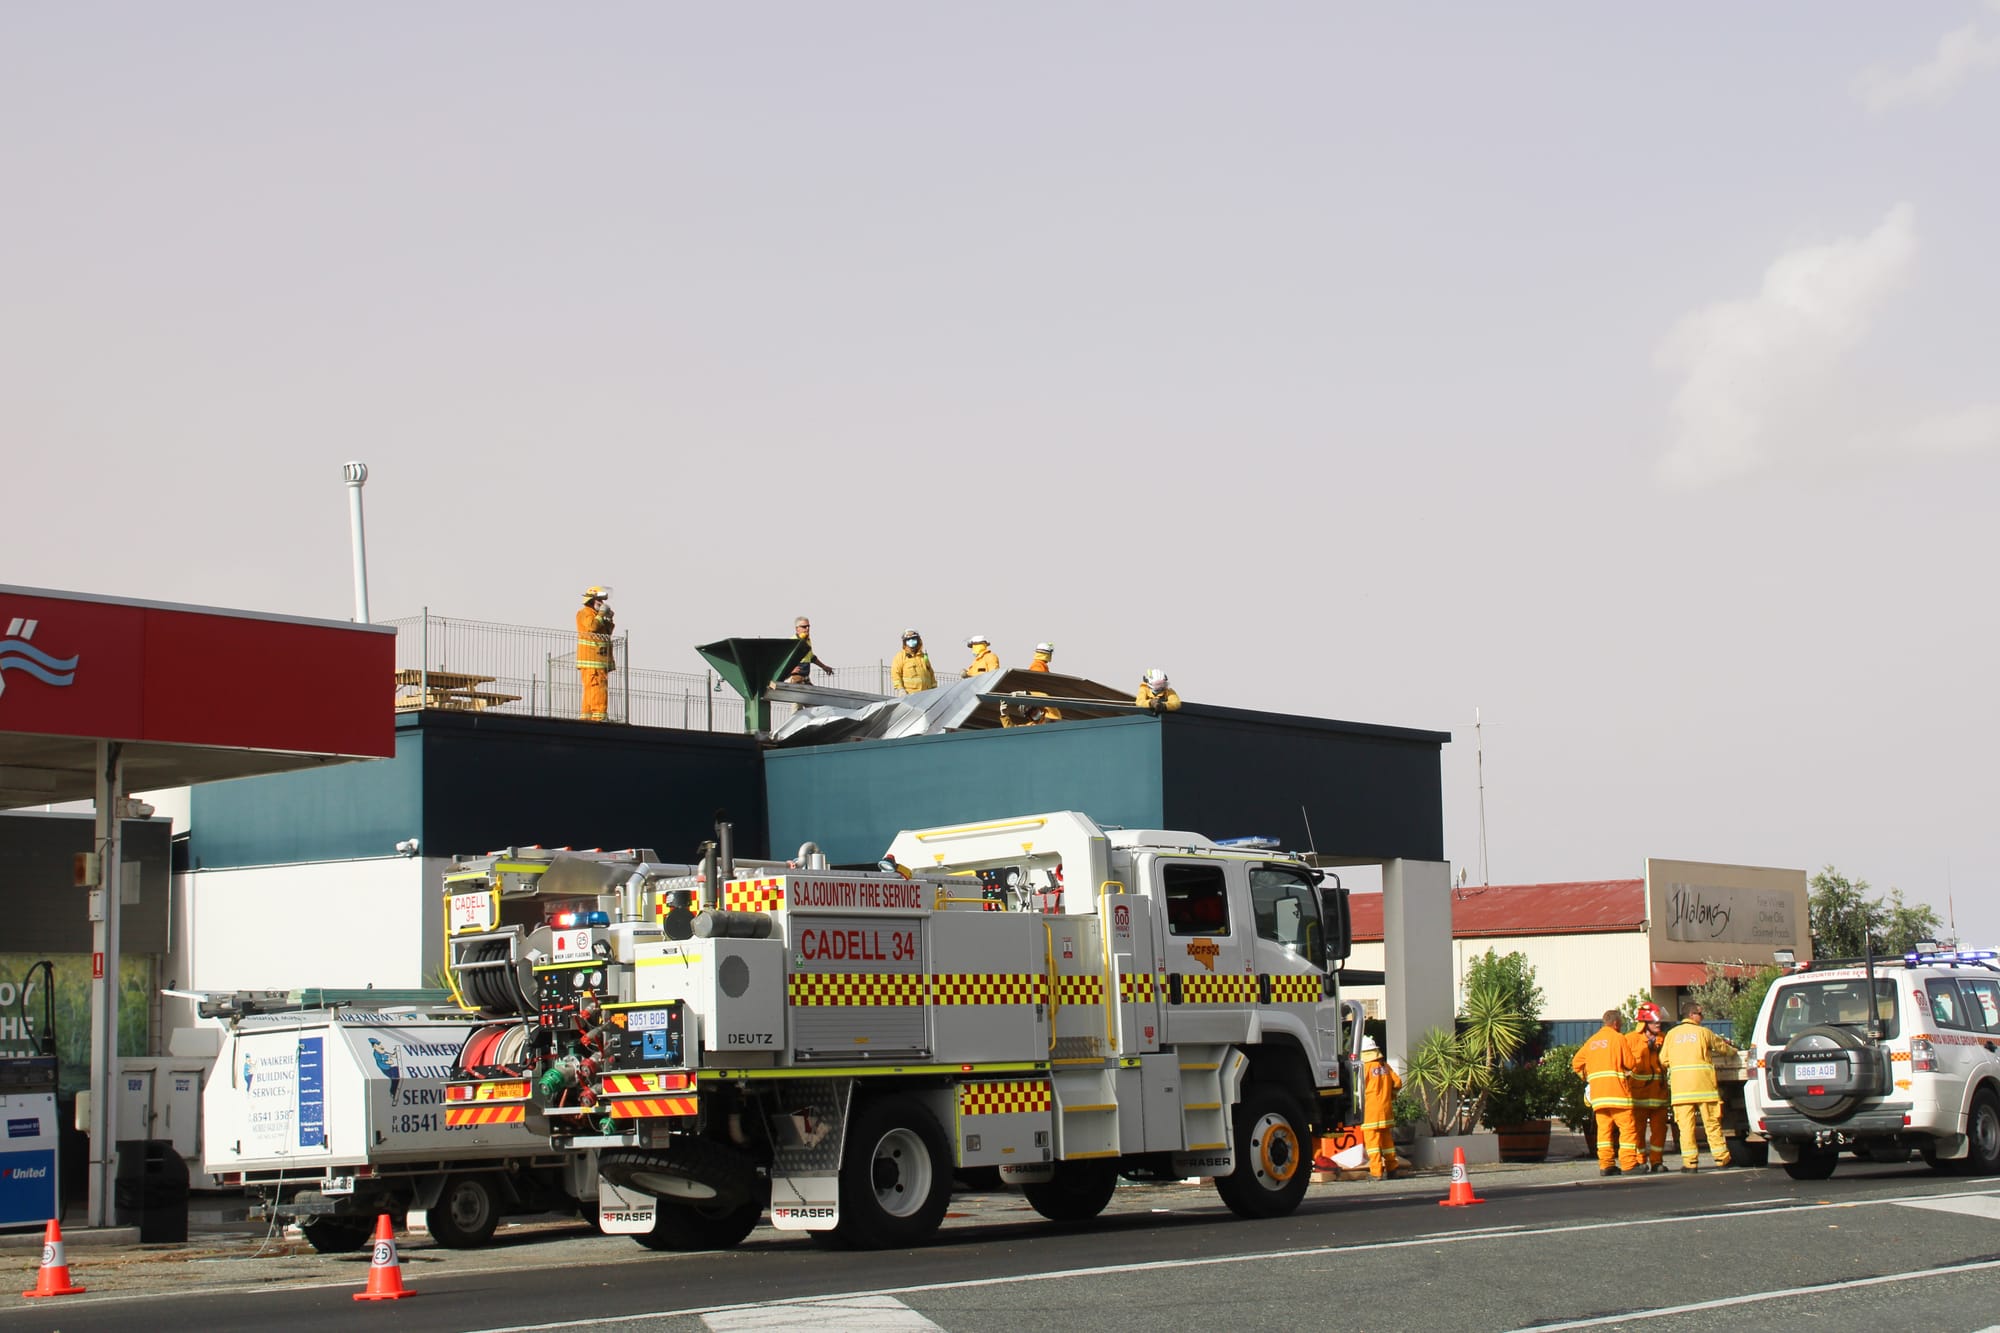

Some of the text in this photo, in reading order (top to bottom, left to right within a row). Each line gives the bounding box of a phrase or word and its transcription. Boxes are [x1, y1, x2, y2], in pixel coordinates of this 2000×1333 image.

[793, 880, 922, 909] S.A.COUNTRY FIRE SERVICE
[454, 895, 486, 911] CADELL
[465, 909, 475, 922] 34
[1671, 889, 1733, 938] Illalangi
[801, 928, 915, 961] CADELL 34
[1194, 944, 1212, 955] CFS
[728, 1033, 773, 1045] DEUTZ
[403, 1043, 464, 1057] WAIKERI
[260, 1055, 295, 1067] WAIKERIE
[256, 1071, 295, 1083] BUILDING
[1796, 1067, 1816, 1078] S868
[252, 1086, 286, 1098] SERVICES
[402, 1088, 446, 1106] SERVI
[252, 1111, 272, 1123] 8541
[400, 1113, 438, 1133] 8541
[13, 1167, 47, 1179] United
[375, 1247, 388, 1260] 25
